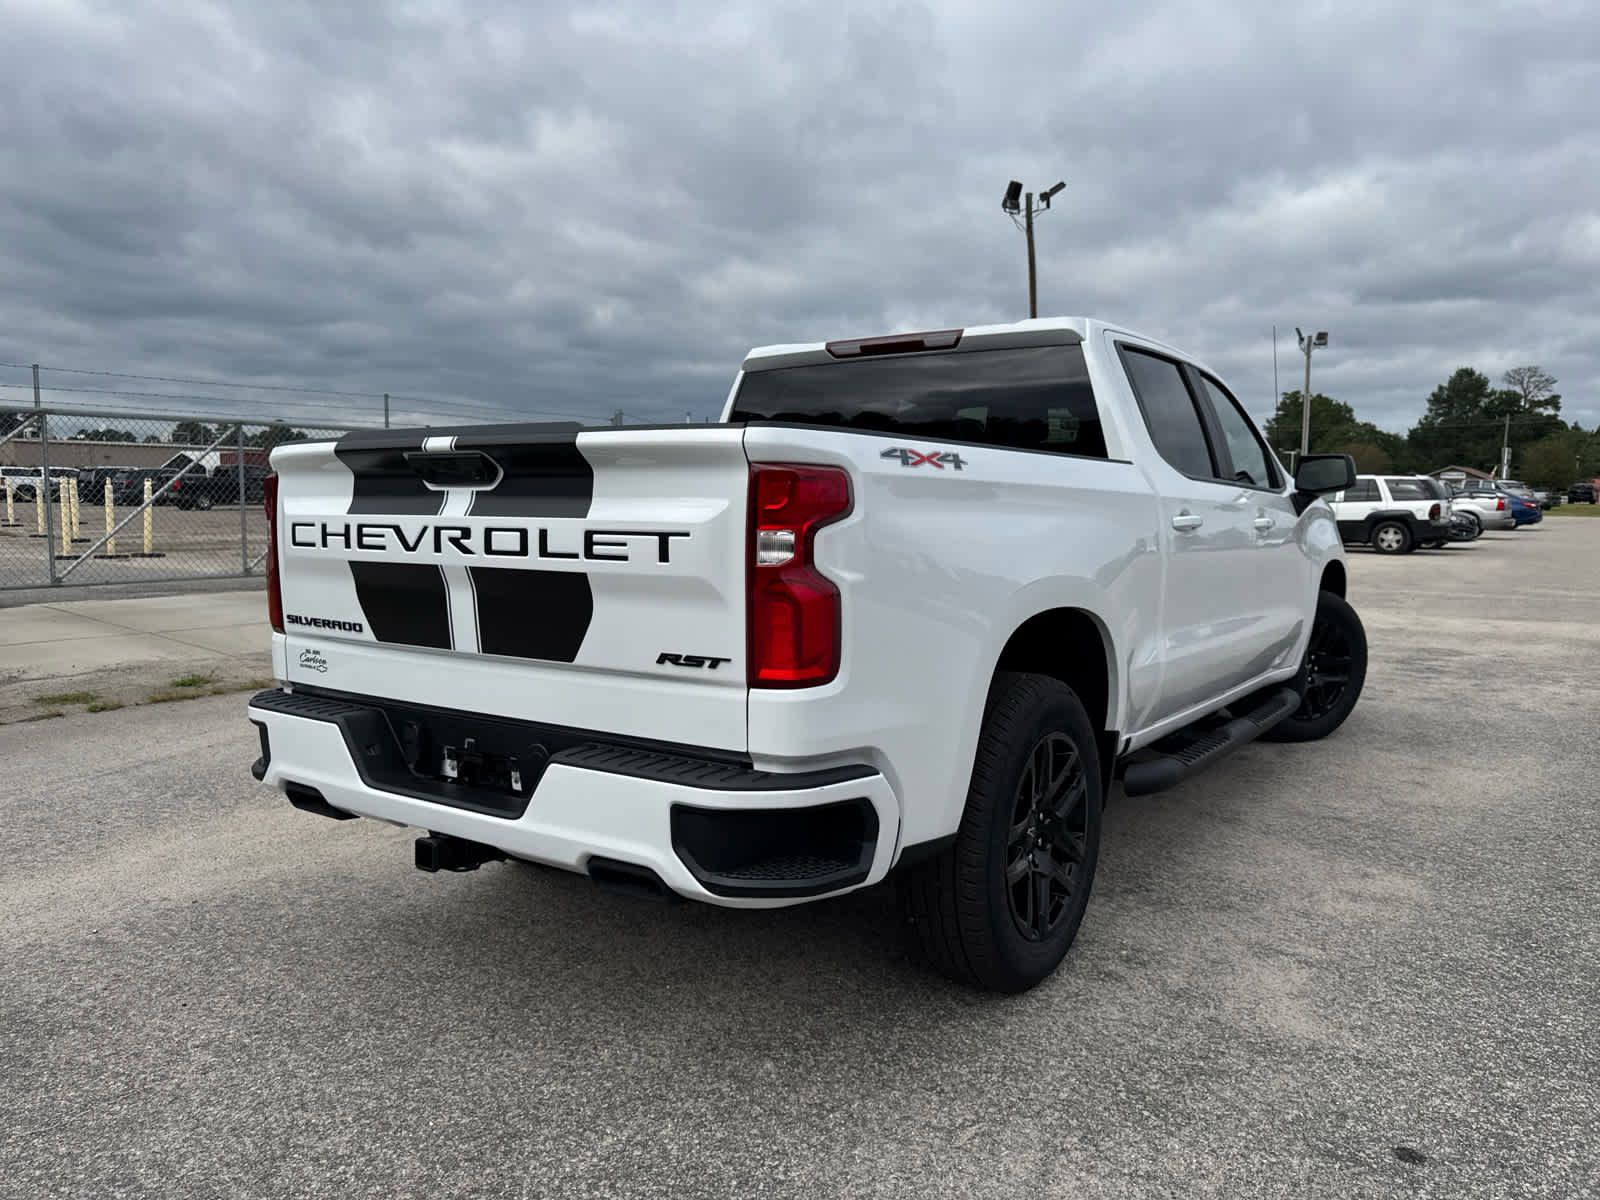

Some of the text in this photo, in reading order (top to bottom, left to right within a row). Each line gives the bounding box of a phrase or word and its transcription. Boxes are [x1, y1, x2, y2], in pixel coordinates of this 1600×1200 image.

[291, 522, 691, 564] CHEVROLET
[286, 614, 364, 633] SILVERADO
[655, 652, 732, 670] RST
